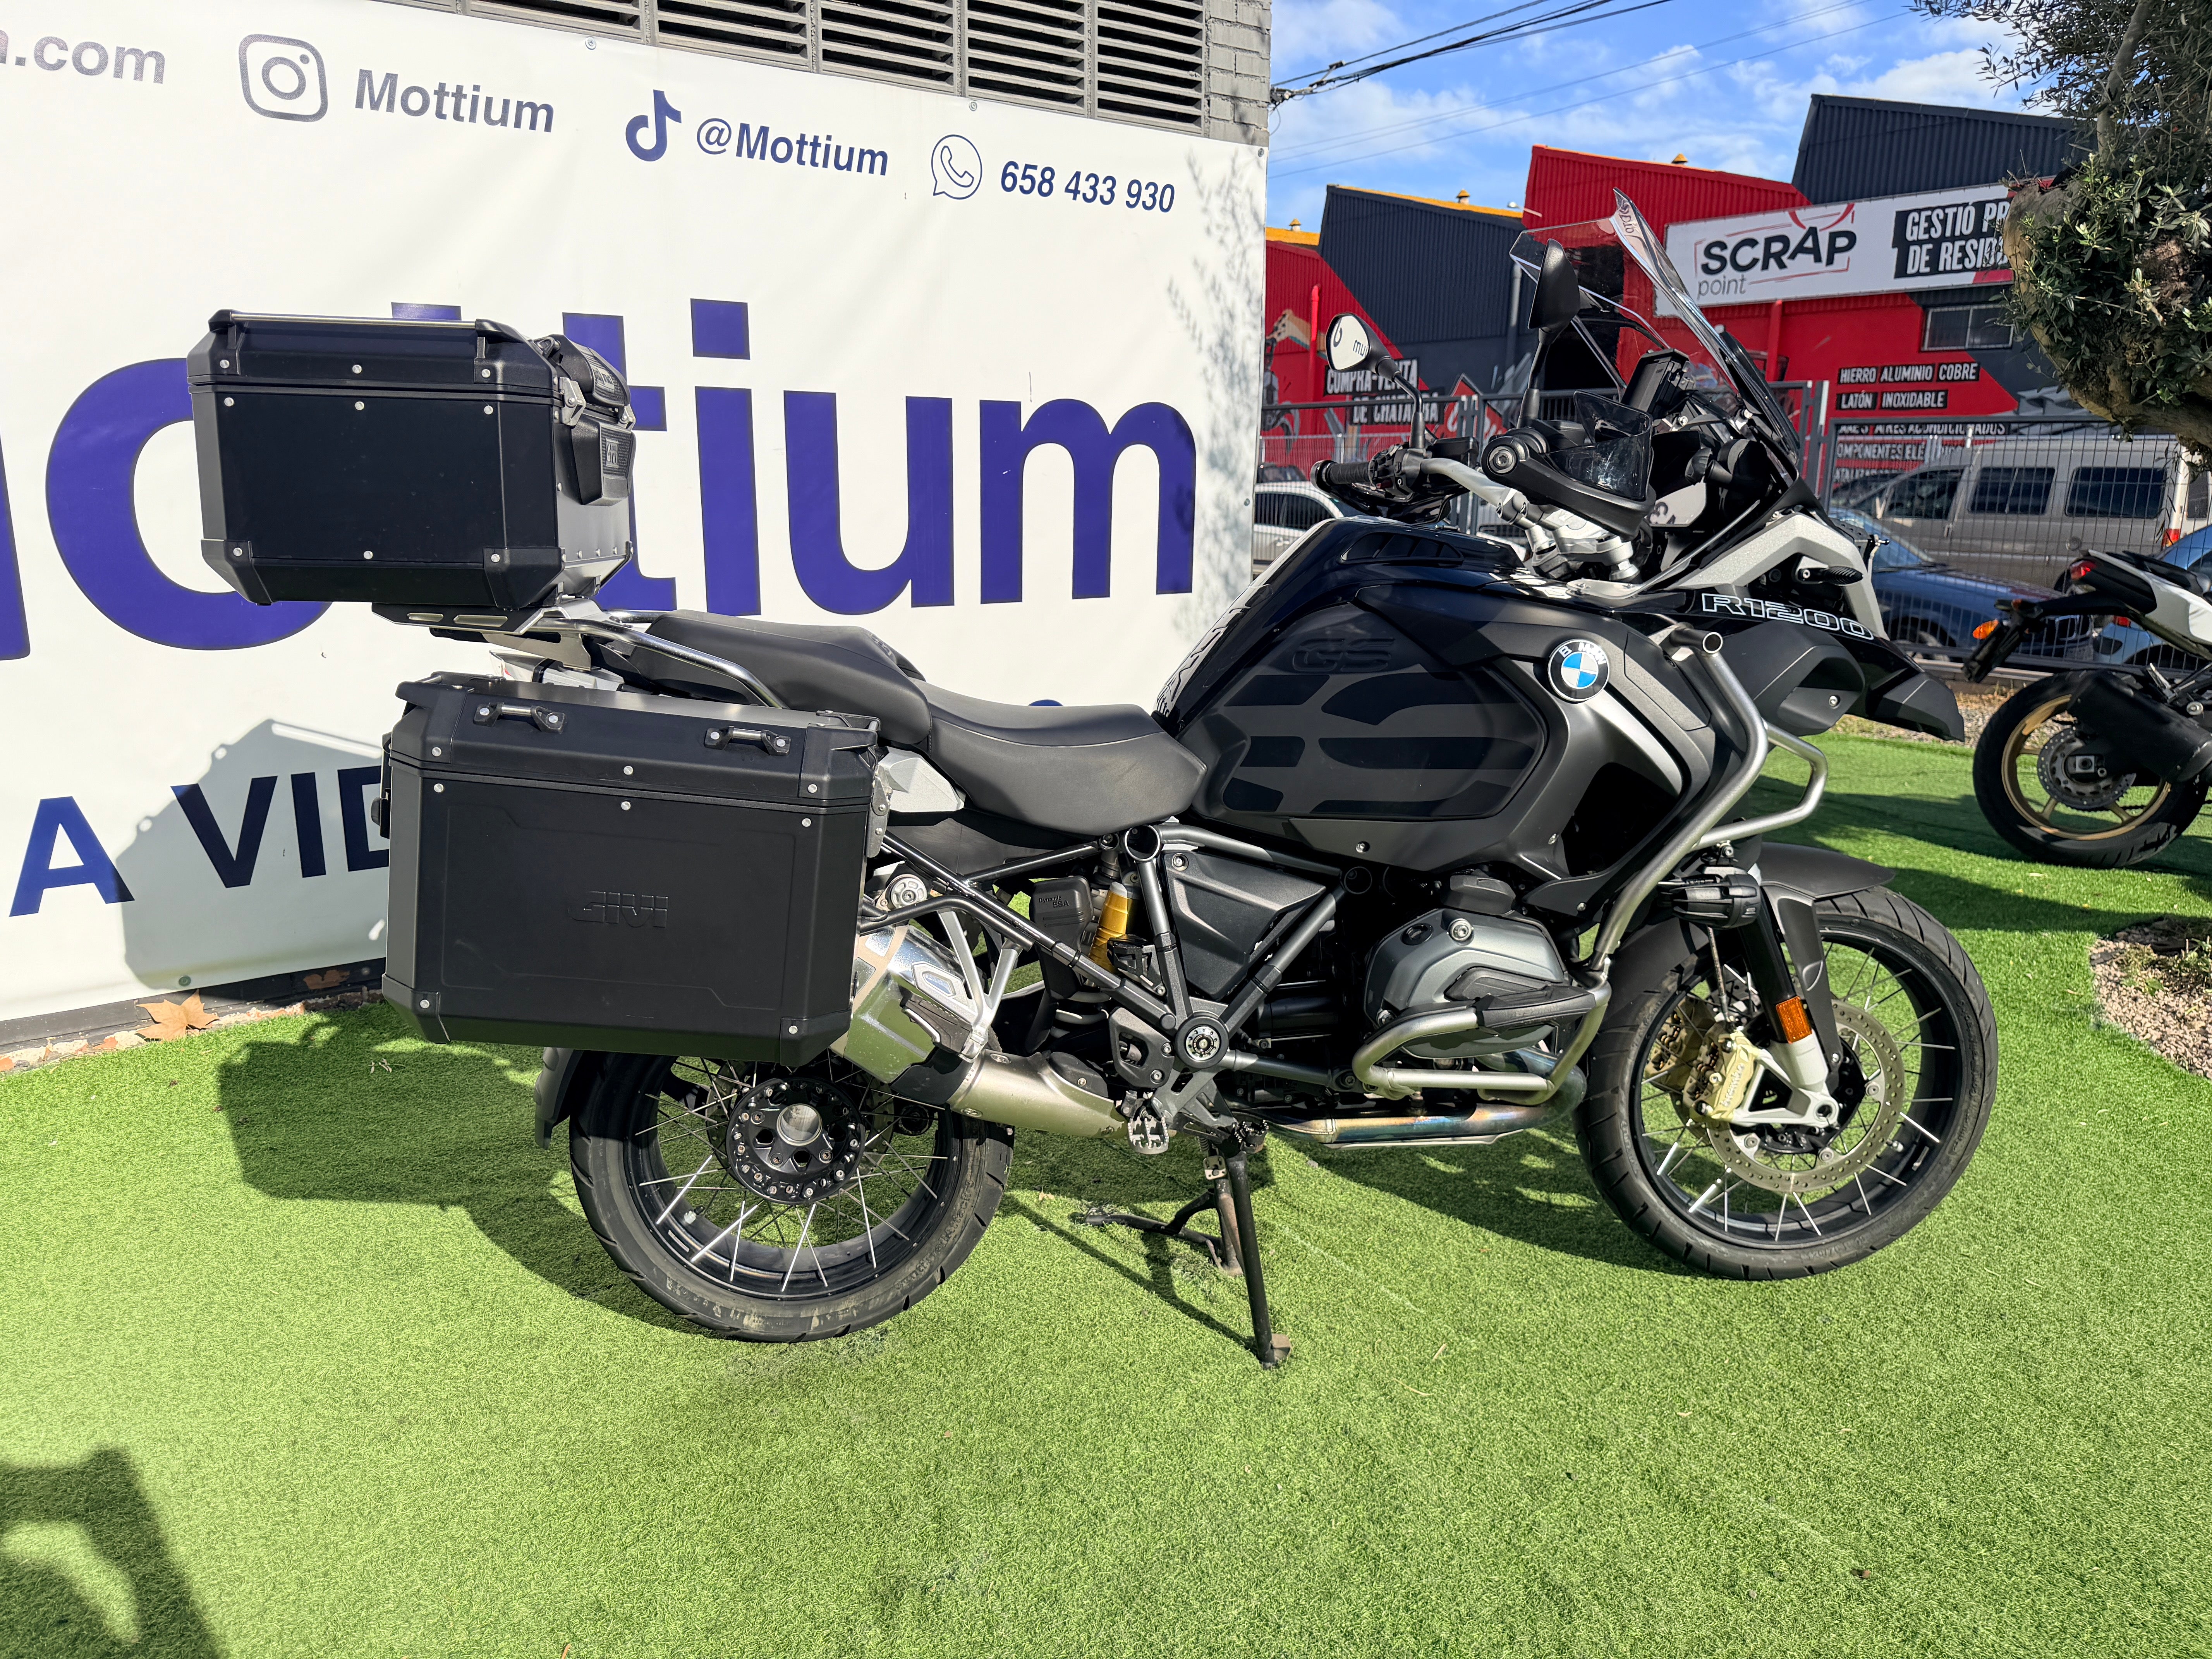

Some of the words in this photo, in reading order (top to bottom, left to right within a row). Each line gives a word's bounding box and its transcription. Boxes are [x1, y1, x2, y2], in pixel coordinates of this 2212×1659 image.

[355, 69, 554, 132] Mottium
[696, 118, 888, 176] @Mottium
[1001, 160, 1056, 198] 658
[1064, 170, 1117, 206] 433
[1125, 179, 1175, 213] 930
[1905, 201, 1976, 242] GESTIÓ
[1701, 226, 1857, 275] SCRAP
[1906, 243, 1933, 275] DE
[1697, 273, 1747, 301] point
[1840, 368, 1877, 383] HIERRO
[1880, 365, 1933, 382] ALUMINIO
[1938, 363, 1978, 381] COBRE
[1373, 391, 1439, 423] CHATARA
[1841, 390, 1873, 409] LATÓN
[1882, 392, 1946, 408] INOXIDABLE
[1907, 423, 2005, 434] ACONDICIOADOS
[1837, 442, 1903, 459] OMPONENTES
[1701, 593, 1874, 640] R1200
[1292, 638, 1396, 673] GS
[1558, 642, 1607, 665] BMW
[9, 795, 136, 917] A
[568, 891, 668, 928] GIVI
[1039, 895, 1062, 903] Dynamic
[1053, 900, 1070, 908] ESA
